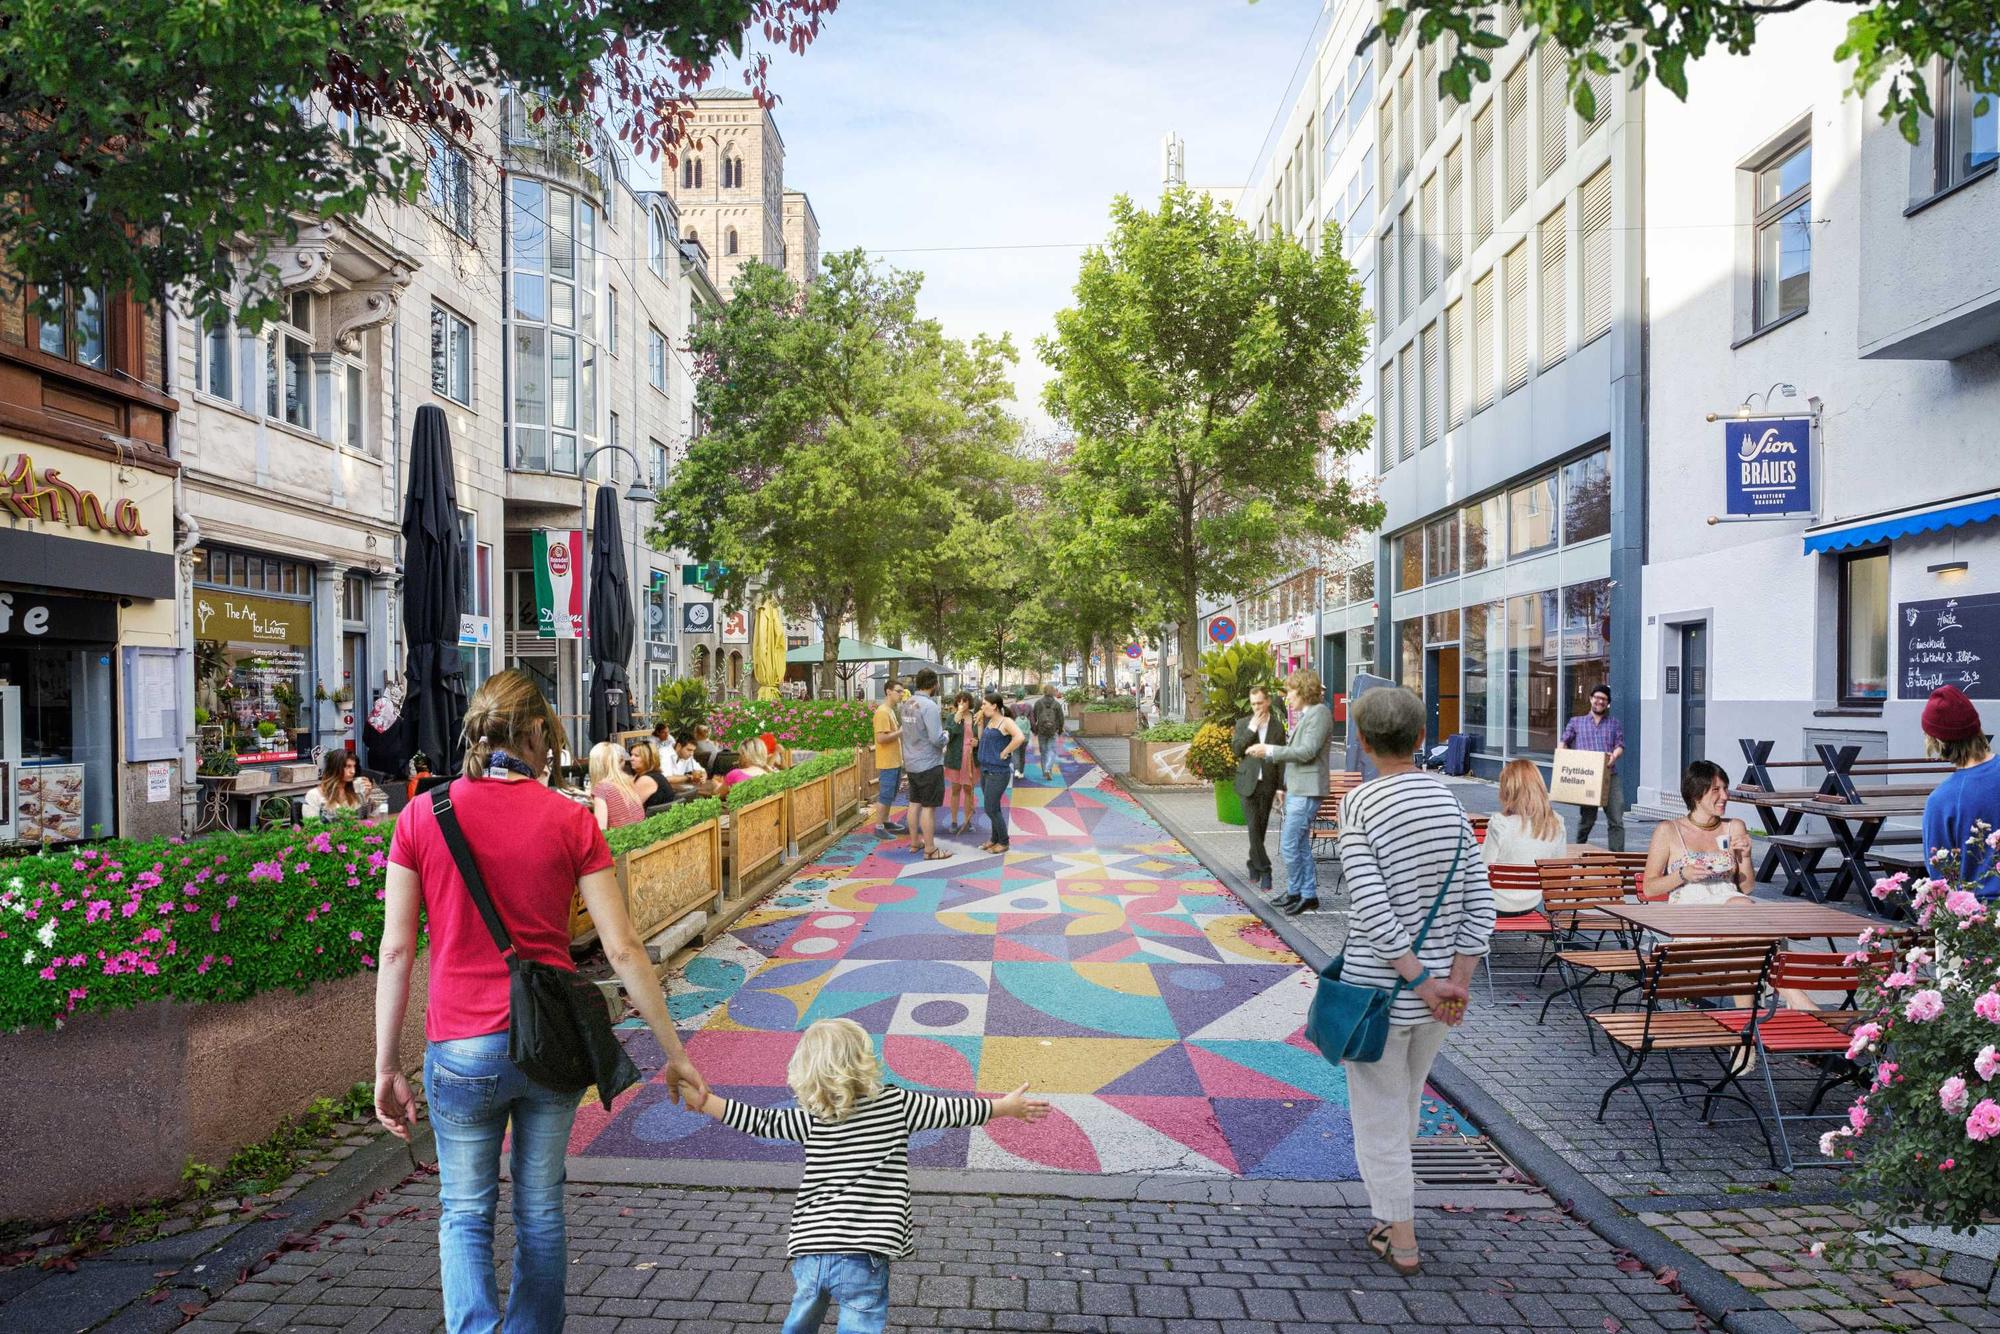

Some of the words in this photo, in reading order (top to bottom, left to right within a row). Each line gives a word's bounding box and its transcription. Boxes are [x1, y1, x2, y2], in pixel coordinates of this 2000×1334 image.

[1737, 428, 1797, 462] Sion
[1741, 459, 1797, 485] BRÄUES
[225, 603, 240, 619] The
[241, 604, 257, 621] Art
[253, 619, 263, 633] for
[264, 619, 286, 638] Living
[1946, 652, 1953, 663] &
[1560, 776, 1585, 785] Mellan
